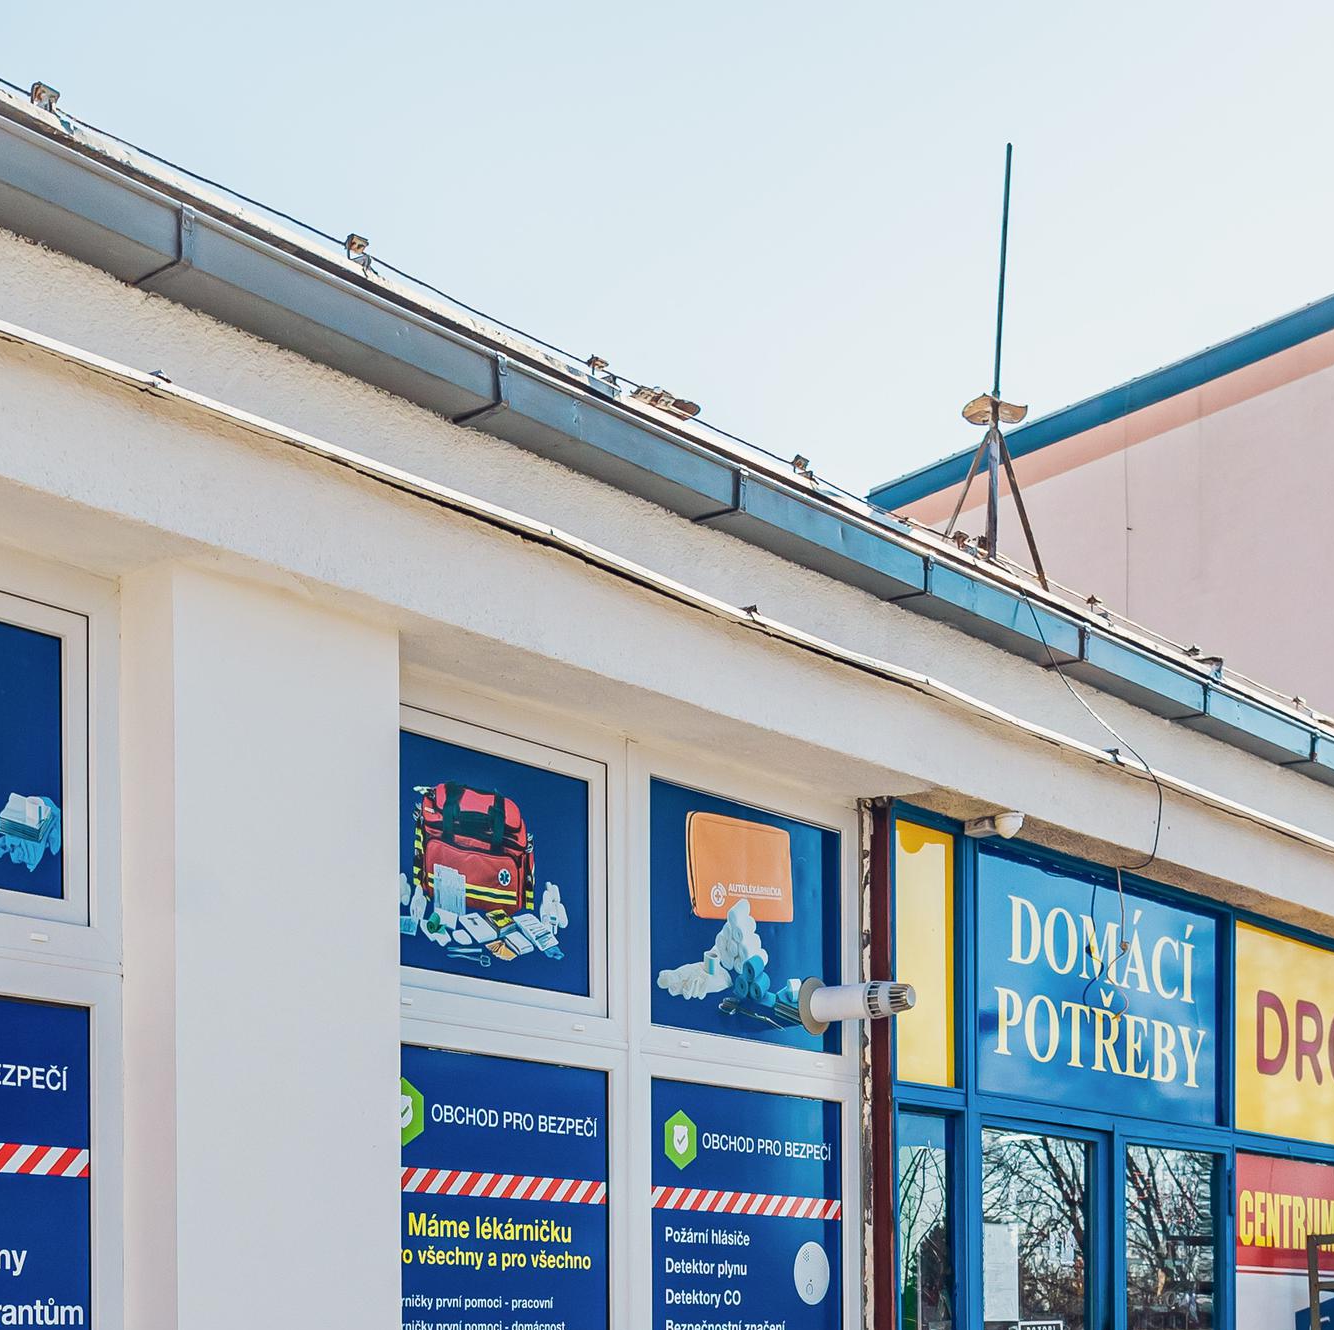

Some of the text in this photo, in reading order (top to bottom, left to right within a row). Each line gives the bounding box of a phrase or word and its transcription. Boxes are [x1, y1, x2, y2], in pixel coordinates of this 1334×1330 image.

[1007, 893, 1195, 1004] DOMÁCÍ
[993, 986, 1206, 1088] POTŘEBY
[431, 1103, 598, 1138] OBCHOD PRO BEZPEČÍ
[702, 1133, 831, 1161] OBCHOD PRO BEZPEČÍ
[408, 1212, 572, 1243] Máme lékárničku
[665, 1226, 751, 1247] Požární hlásiče
[418, 1245, 484, 1270] všechny
[488, 1251, 497, 1266] a
[501, 1252, 527, 1271] pro
[531, 1250, 592, 1270] všechno
[665, 1257, 747, 1279] Detektor plynu
[436, 1295, 462, 1311] první
[464, 1296, 503, 1311] pomoci
[511, 1296, 554, 1312] pracovní
[665, 1288, 741, 1308] Detektory CO
